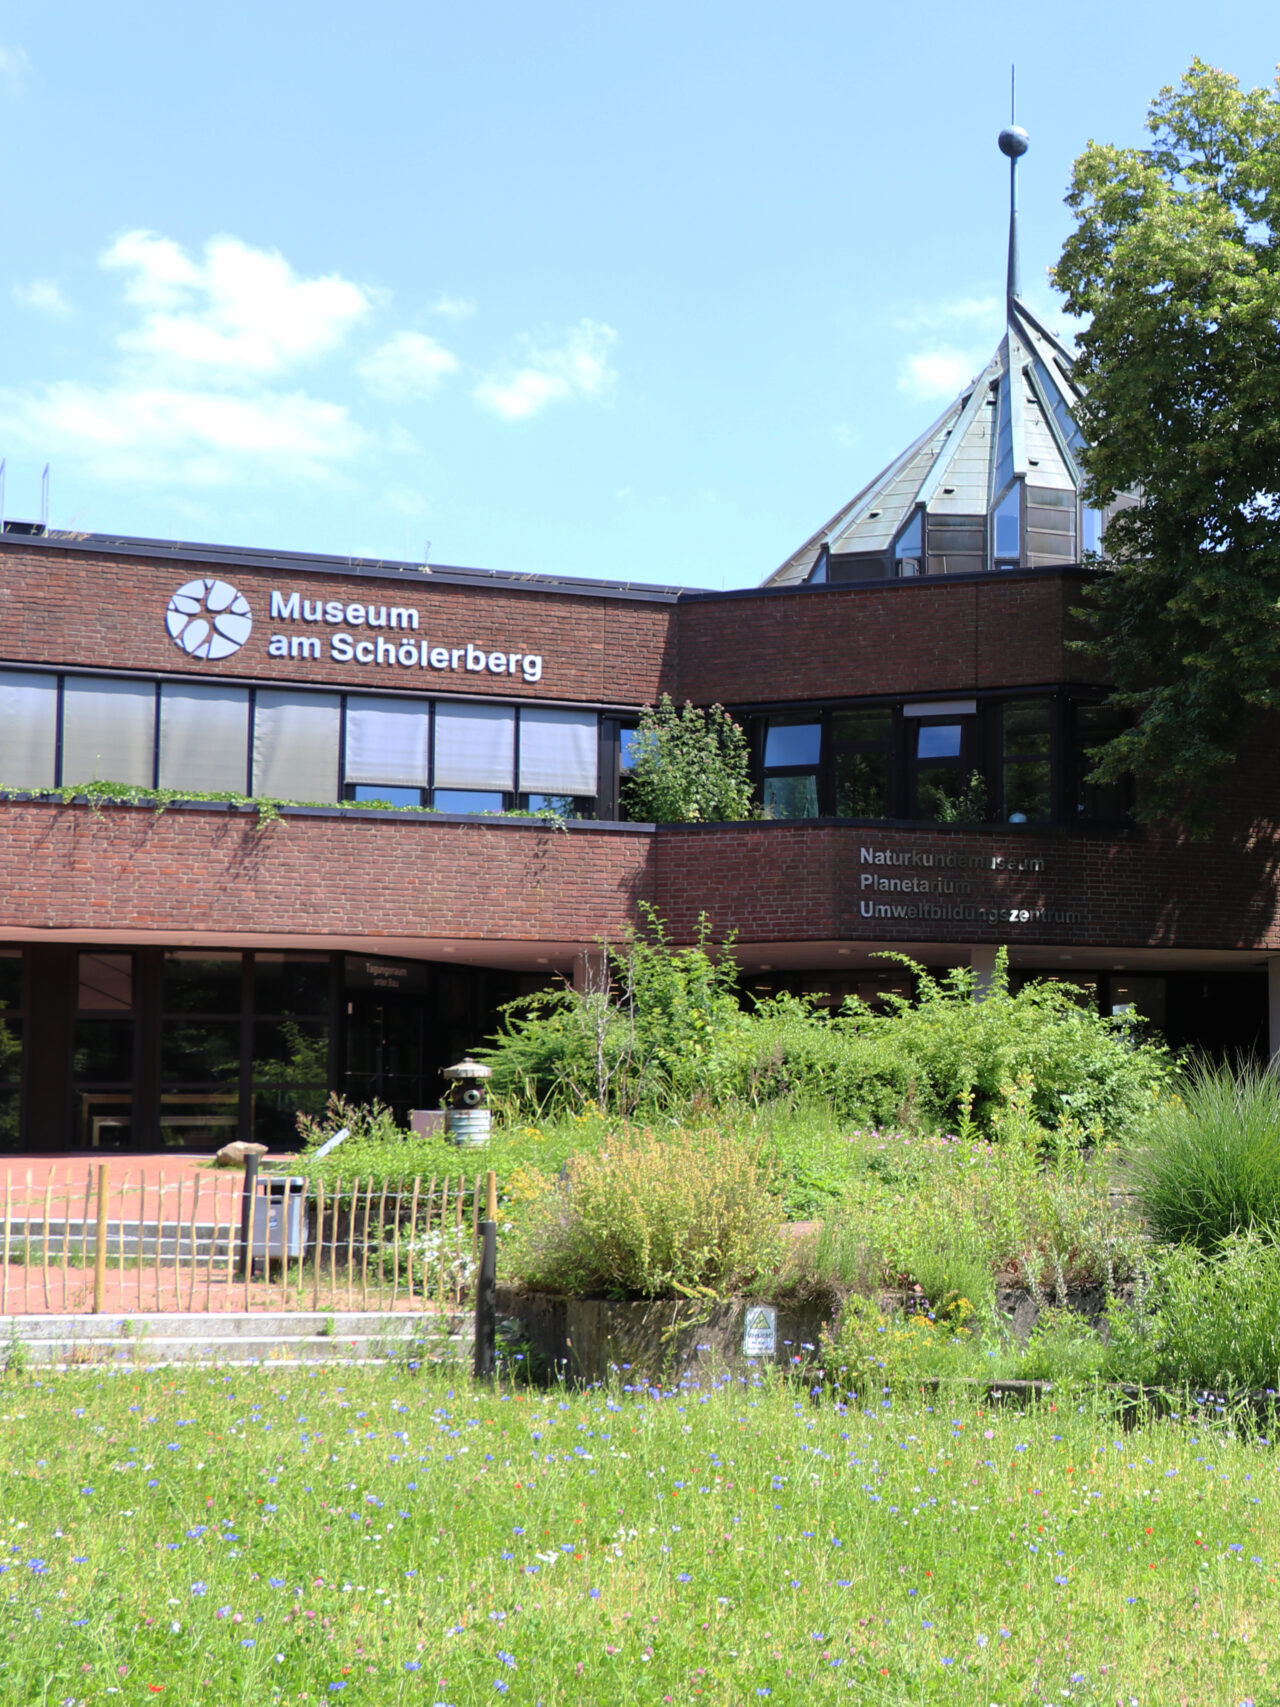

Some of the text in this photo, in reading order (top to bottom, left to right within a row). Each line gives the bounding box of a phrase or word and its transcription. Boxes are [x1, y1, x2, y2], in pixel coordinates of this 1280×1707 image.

[269, 590, 419, 629] Museum
[268, 633, 543, 682] am Schölerberg
[860, 848, 1045, 871] Naturkundemuseum
[860, 874, 971, 894] Planetarium
[860, 901, 1081, 924] Umweltbildungszentrum
